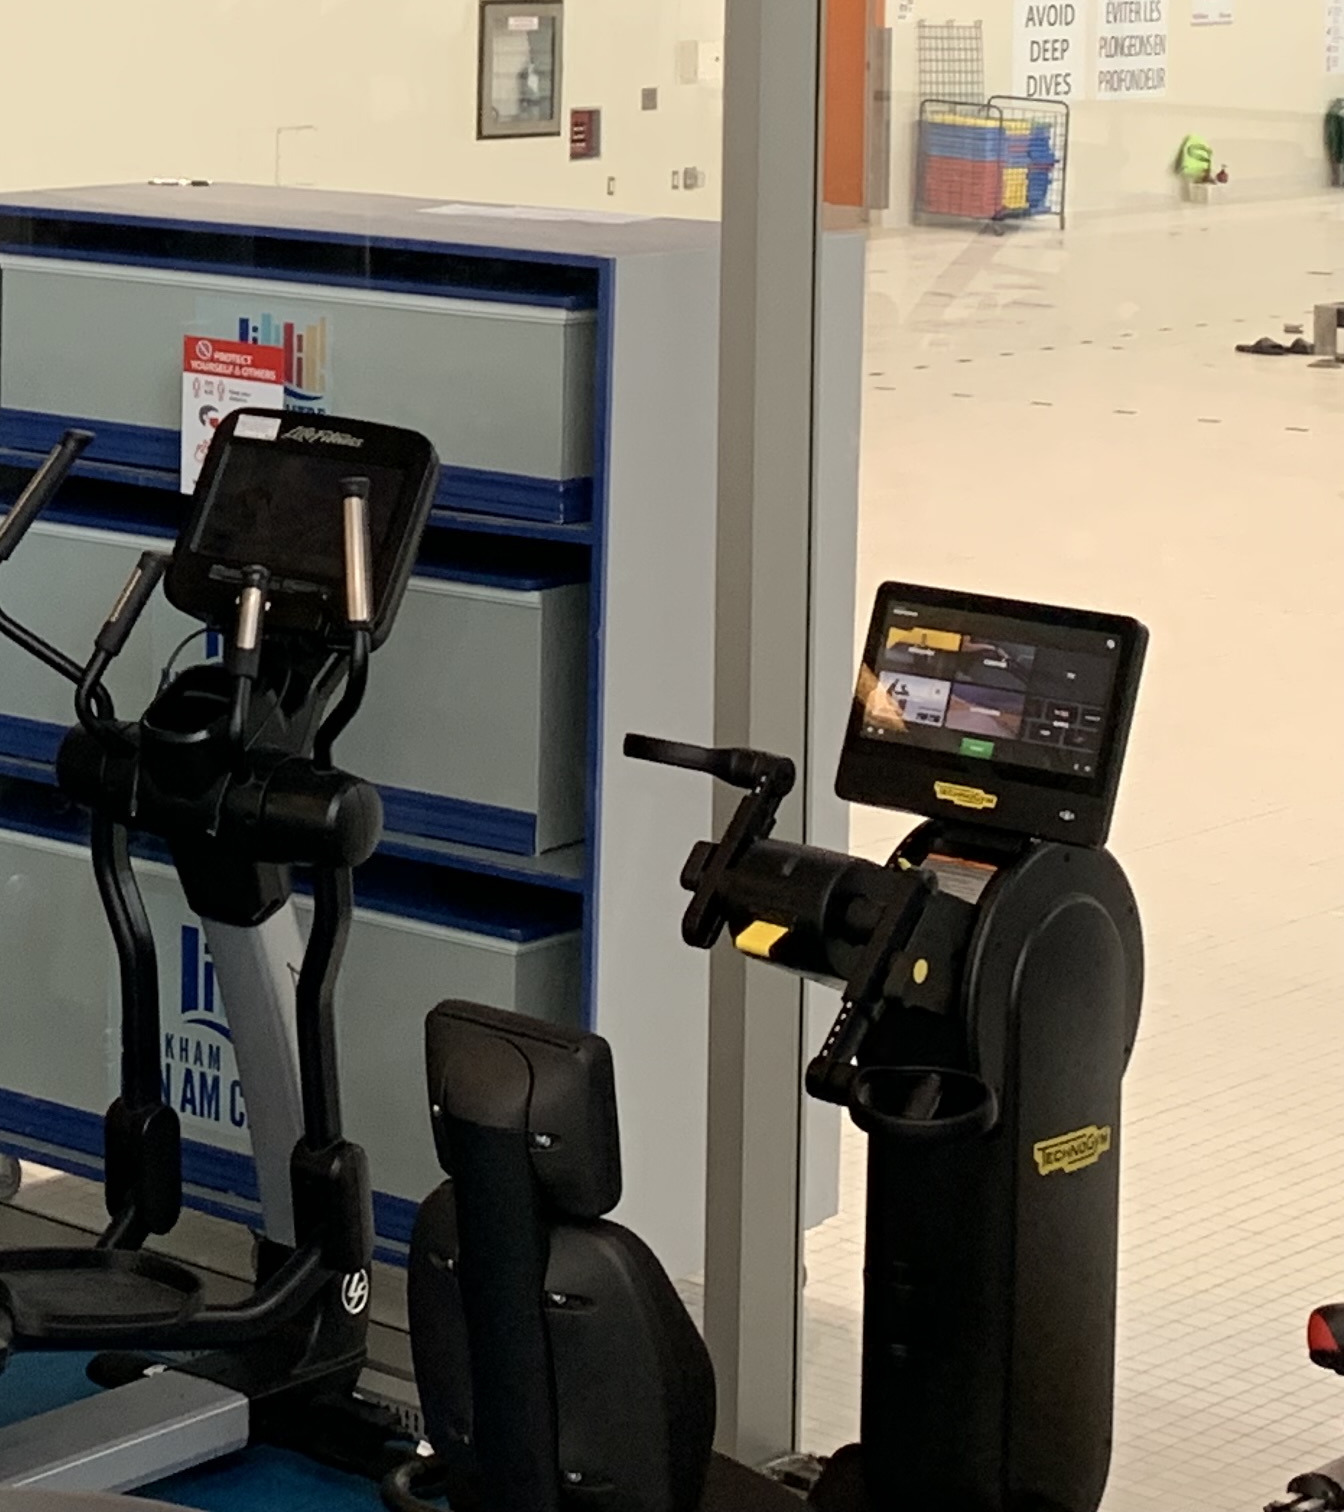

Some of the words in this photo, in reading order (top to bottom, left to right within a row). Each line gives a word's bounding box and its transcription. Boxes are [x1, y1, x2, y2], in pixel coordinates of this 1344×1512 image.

[1025, 4, 1075, 28] AVOID
[1143, 0, 1162, 23] LES
[1030, 39, 1070, 62] DEEP
[1099, 35, 1153, 58] PLONGEONS
[1154, 34, 1166, 56] EN
[1026, 73, 1072, 98] DIVES
[1098, 68, 1166, 92] PROFONDEUR
[190, 360, 233, 375] YOURSELF
[241, 367, 276, 380] OTHERS
[213, 351, 253, 365] PROTECT
[165, 1032, 220, 1072] KHAM
[181, 1067, 220, 1121] AM
